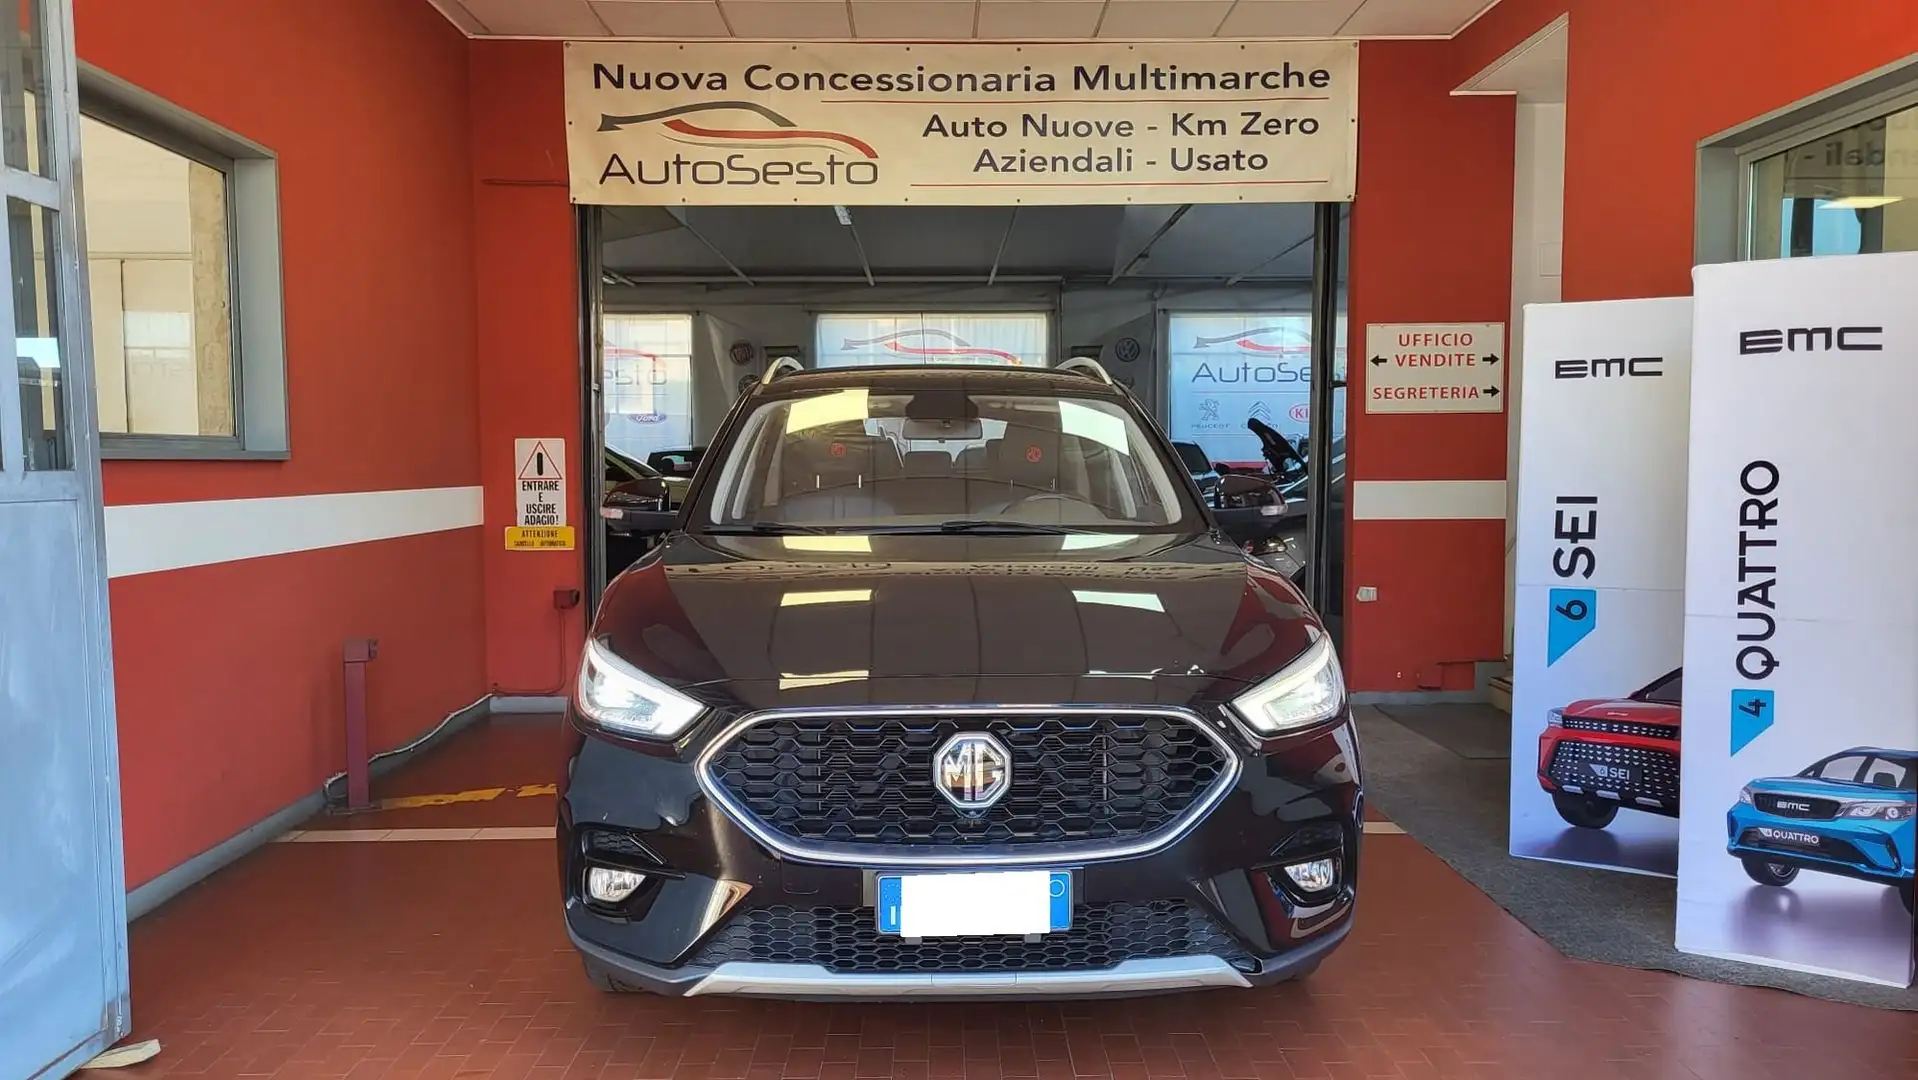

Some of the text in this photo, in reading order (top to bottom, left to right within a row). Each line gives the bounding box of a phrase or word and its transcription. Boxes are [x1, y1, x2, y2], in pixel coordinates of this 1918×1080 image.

[593, 62, 1330, 92] Nuova Concessionaria Multimarche
[922, 114, 1008, 137] Auto
[1022, 113, 1134, 137] Nuove
[1171, 113, 1226, 136] Km
[1240, 111, 1319, 135] Zero
[973, 148, 1132, 173] Aziendali
[1171, 148, 1268, 172] Usato
[599, 153, 879, 185] AutoSesto
[1398, 333, 1473, 346] UFFICIO
[1395, 353, 1476, 367] VENDITE
[1373, 386, 1479, 400] SEGRETERIA
[522, 481, 559, 491] ENTRARE
[538, 492, 543, 502] E
[526, 503, 556, 514] USCIRE
[524, 515, 559, 525] ADAGIO!
[521, 530, 558, 538] ATTENZIONE
[1553, 496, 1598, 620] 6 SEI
[1736, 460, 1780, 718] 4 QUATTRO
[944, 742, 1005, 801] MG
[1609, 767, 1630, 780] SEI
[1773, 830, 1819, 844] QUATTRO
